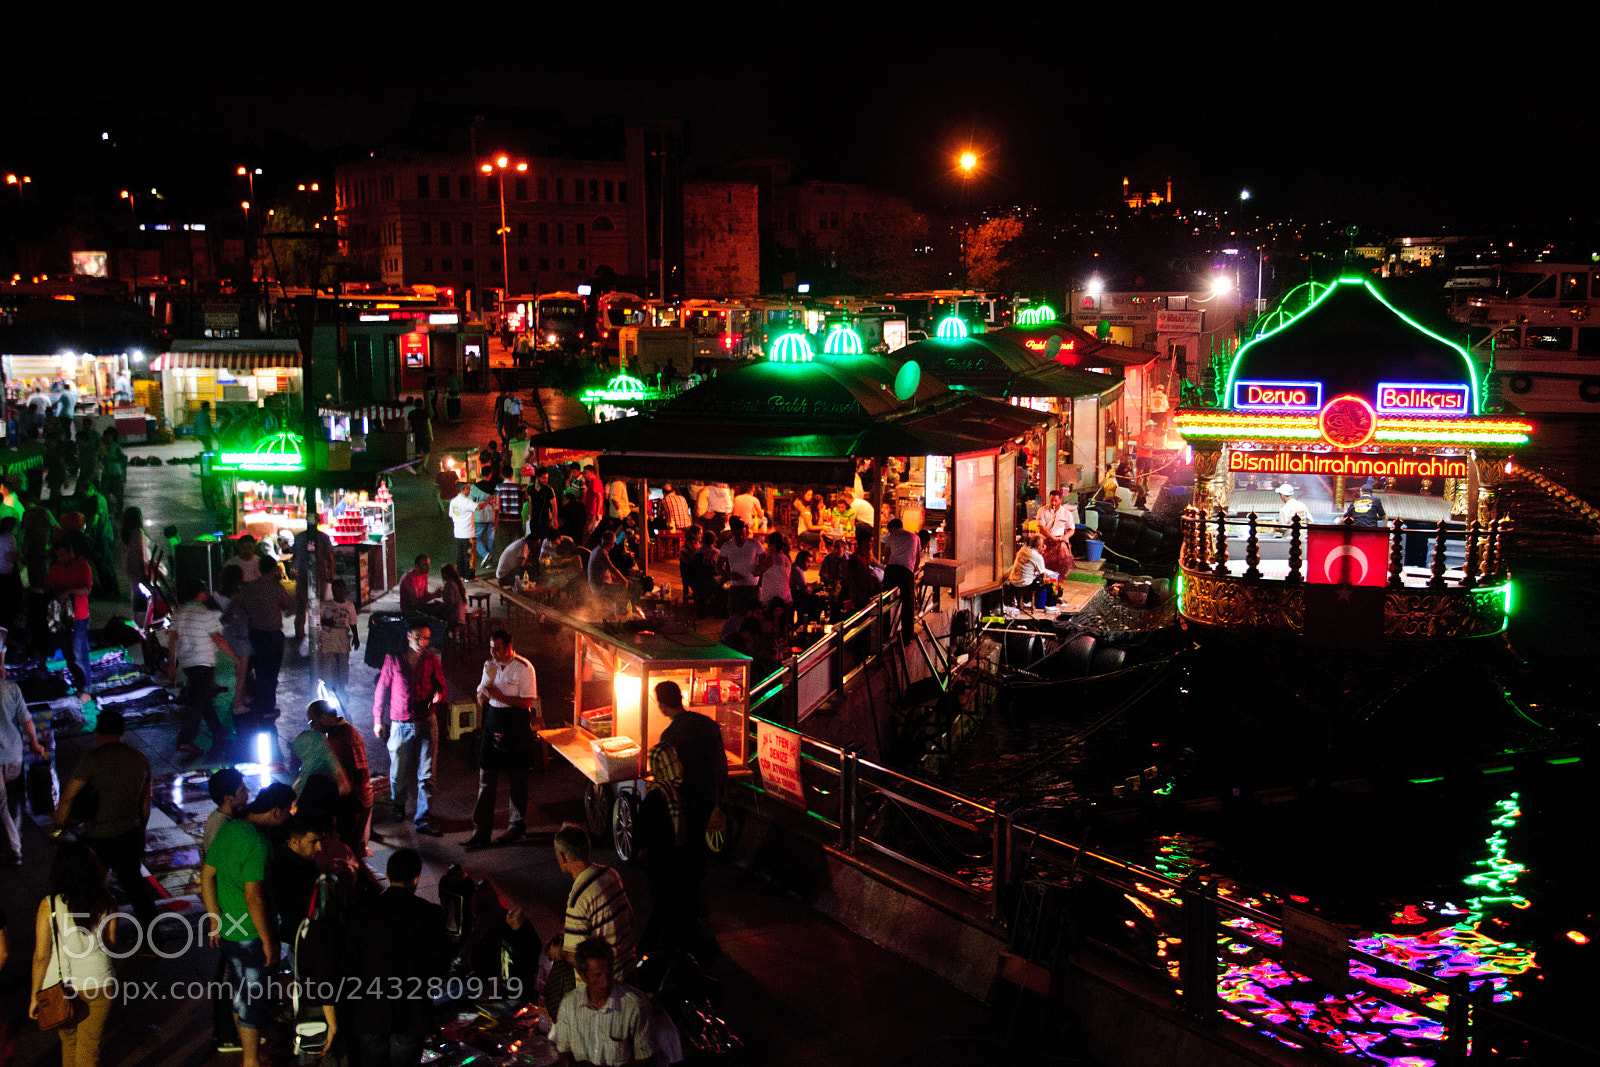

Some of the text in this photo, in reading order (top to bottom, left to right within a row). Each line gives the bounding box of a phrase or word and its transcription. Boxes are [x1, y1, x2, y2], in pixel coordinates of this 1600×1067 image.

[1247, 386, 1462, 411] Derya Balıkçısı
[1230, 451, 1466, 477] Bismillahirrahmanirrahim
